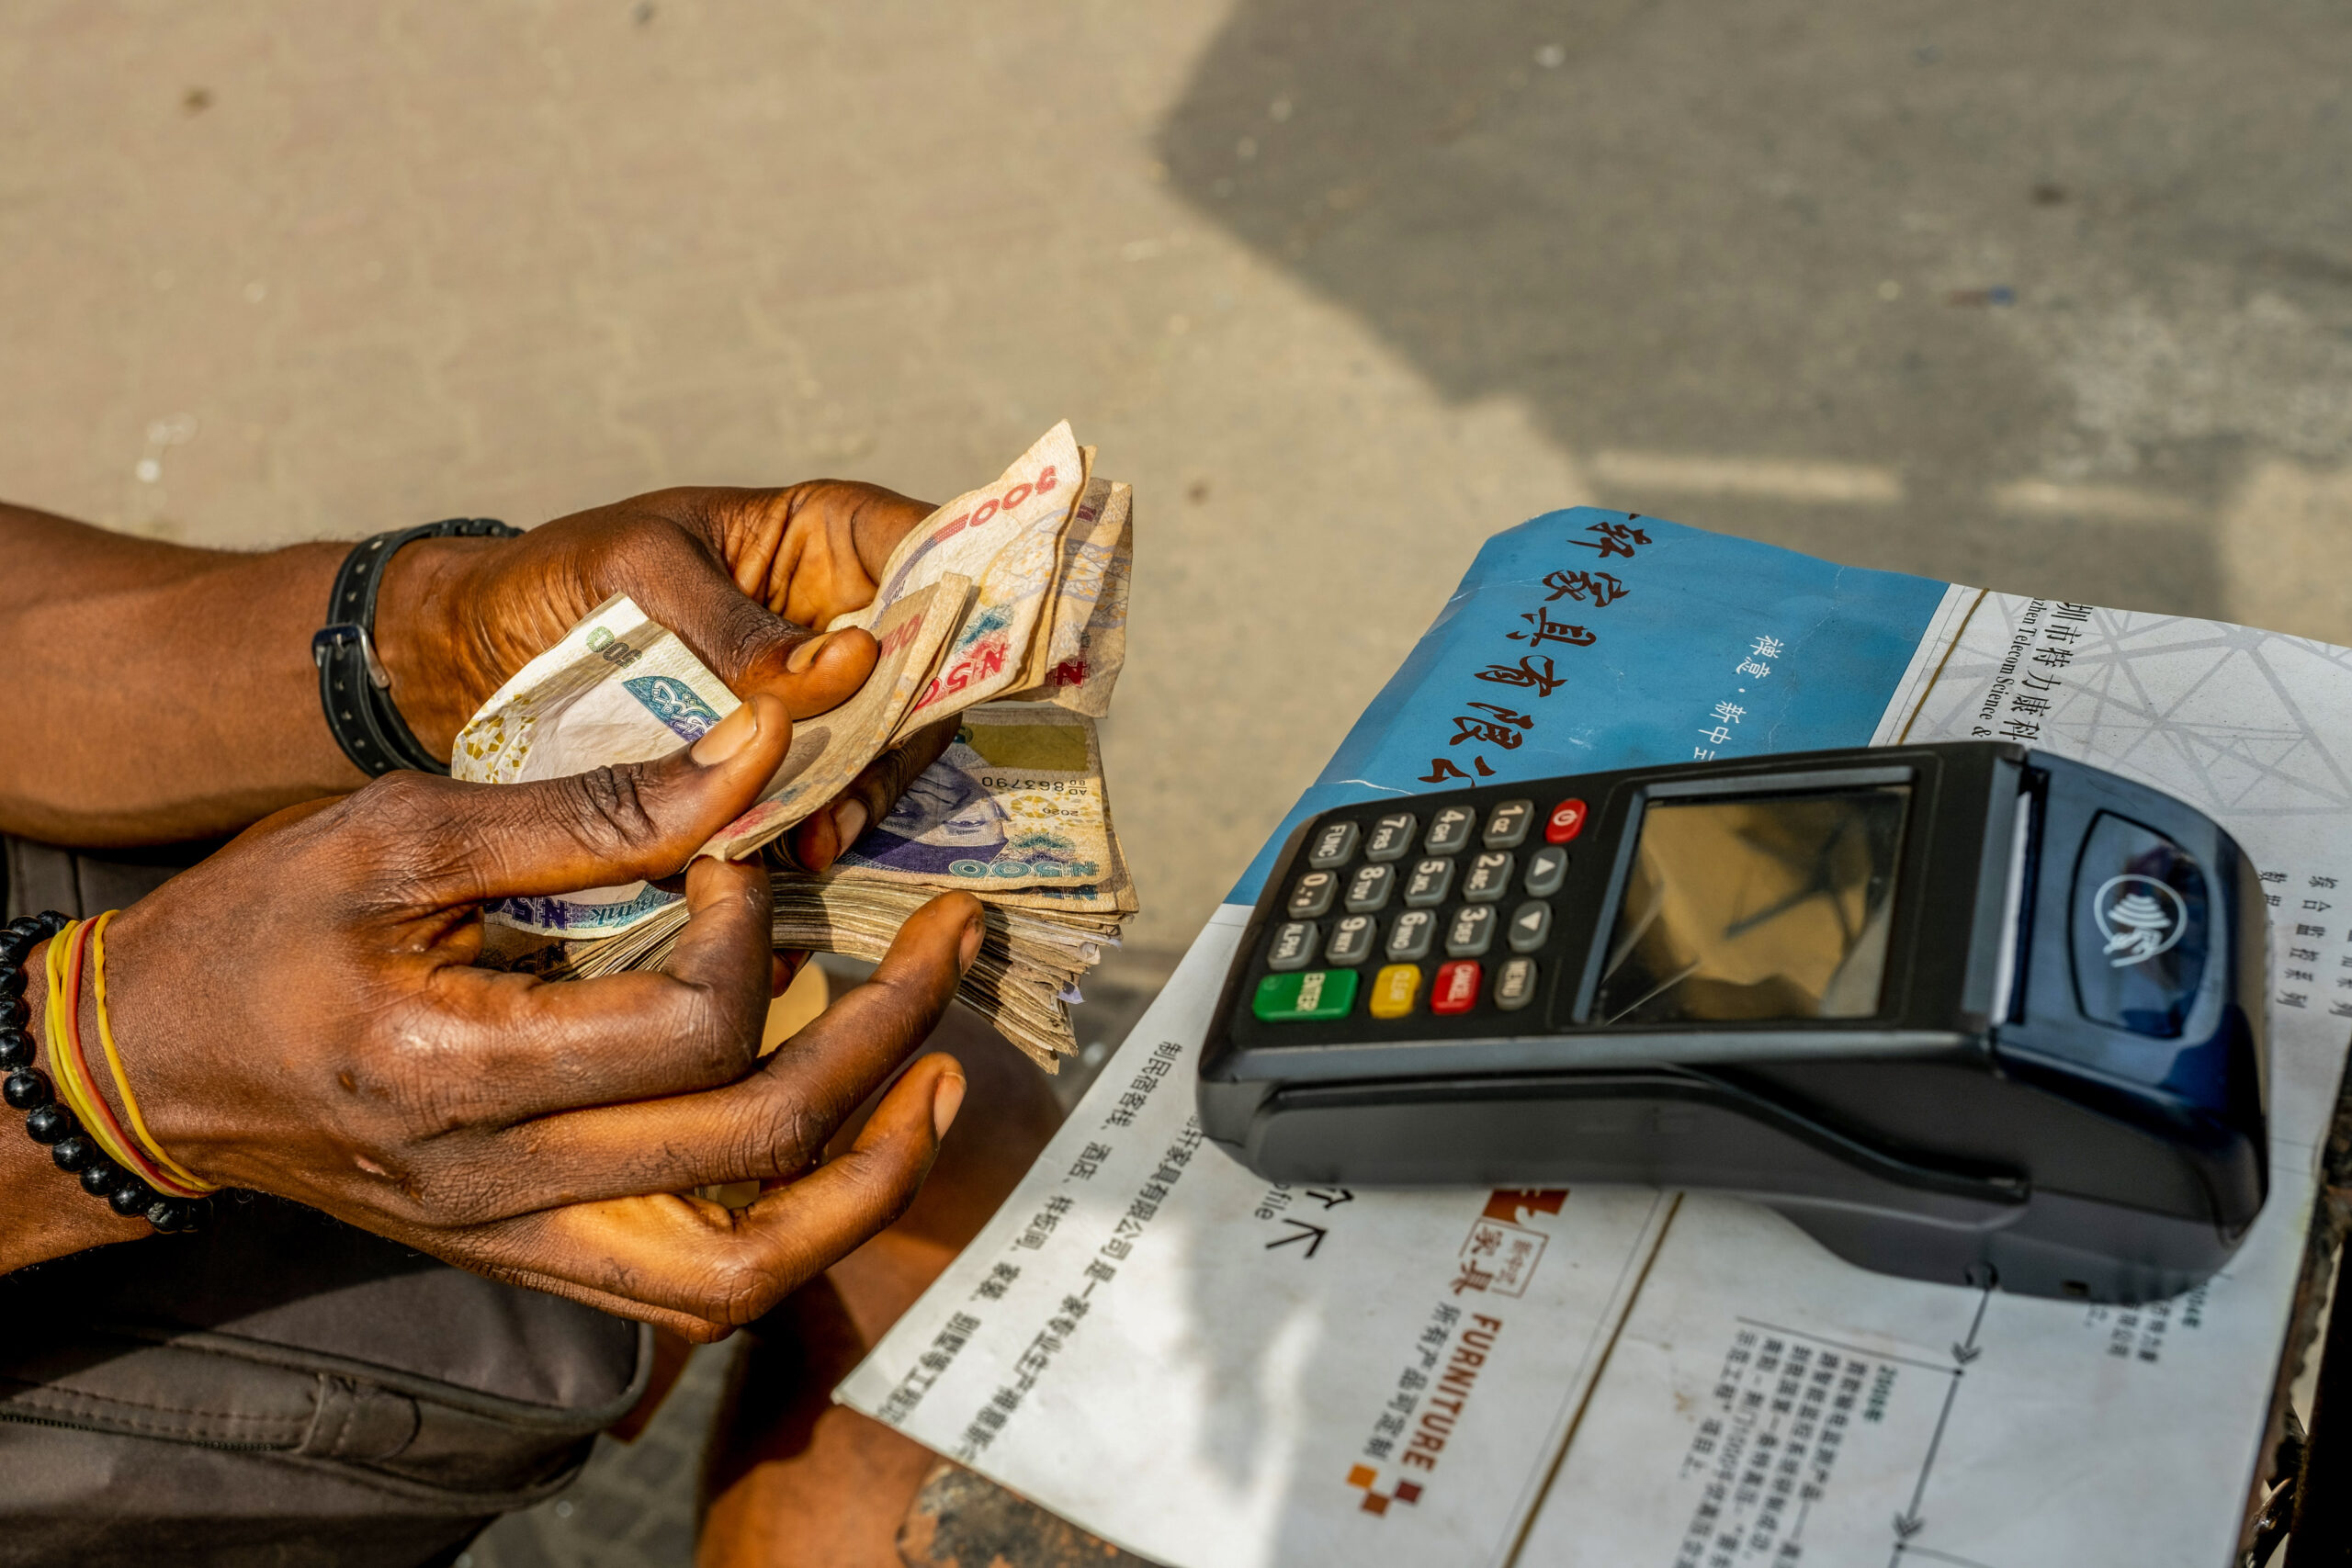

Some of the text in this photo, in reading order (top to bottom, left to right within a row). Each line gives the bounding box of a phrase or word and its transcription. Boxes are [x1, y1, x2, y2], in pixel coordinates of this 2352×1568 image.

[586, 626, 642, 669] 500
[1972, 598, 2047, 738] zhen Telecom Science &
[982, 776, 1064, 792] 863790
[1042, 807, 1079, 817] 2020
[1431, 809, 1464, 842] 4 GHI
[1498, 805, 1523, 816] 1
[1317, 824, 1347, 858] FUNC
[1373, 816, 1407, 851] 7 PRS
[1303, 874, 1329, 886] 0
[1351, 866, 1385, 900] 8 TUV
[1410, 861, 1445, 895] 5 JKL
[1469, 853, 1505, 890] 2 ABC
[590, 891, 657, 926] Bank
[1340, 917, 1366, 931] 9
[1400, 912, 1428, 926] 6
[1454, 907, 1487, 944] 3 DEF
[1277, 923, 1305, 959] ALPHA
[1295, 973, 1326, 1012] ENTER
[1390, 970, 1411, 1001] CLEAR
[1447, 964, 1474, 1002] CANCEL
[1501, 961, 1528, 998] MENU
[1449, 1225, 1503, 1296] 家具
[1400, 1312, 1503, 1473] FURNITURE
